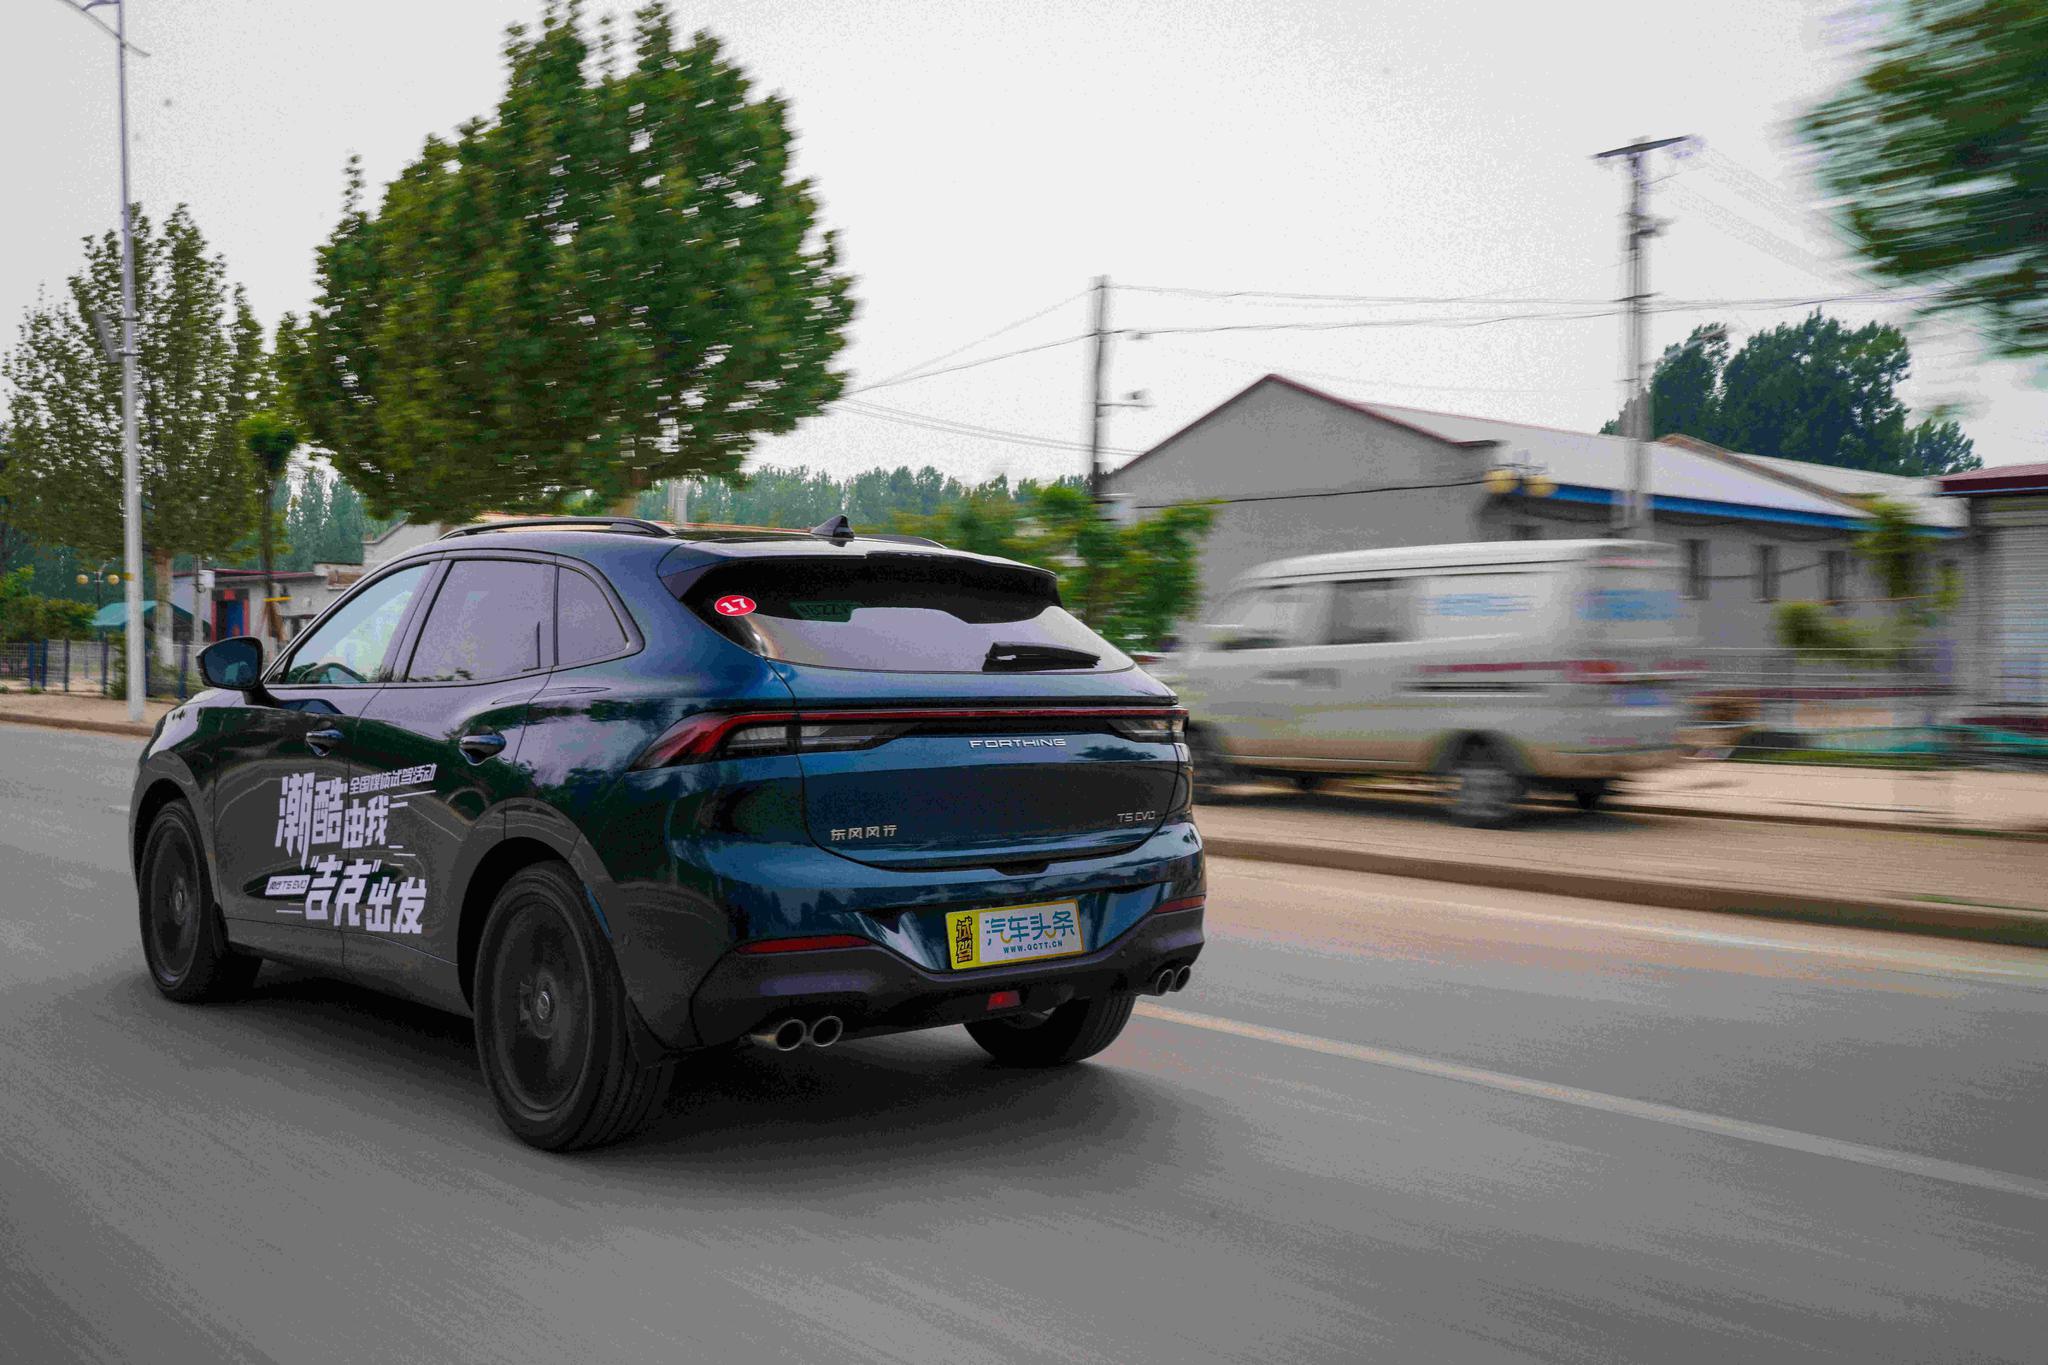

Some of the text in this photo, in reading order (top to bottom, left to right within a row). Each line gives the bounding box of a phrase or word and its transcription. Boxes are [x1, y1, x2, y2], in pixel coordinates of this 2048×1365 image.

[720, 598, 747, 613] 17
[969, 738, 1067, 749] FORTHING
[830, 824, 897, 841] 东风风行
[985, 910, 1076, 946] 汽车头条
[1002, 940, 1063, 954] WWW.QCTT.CN
